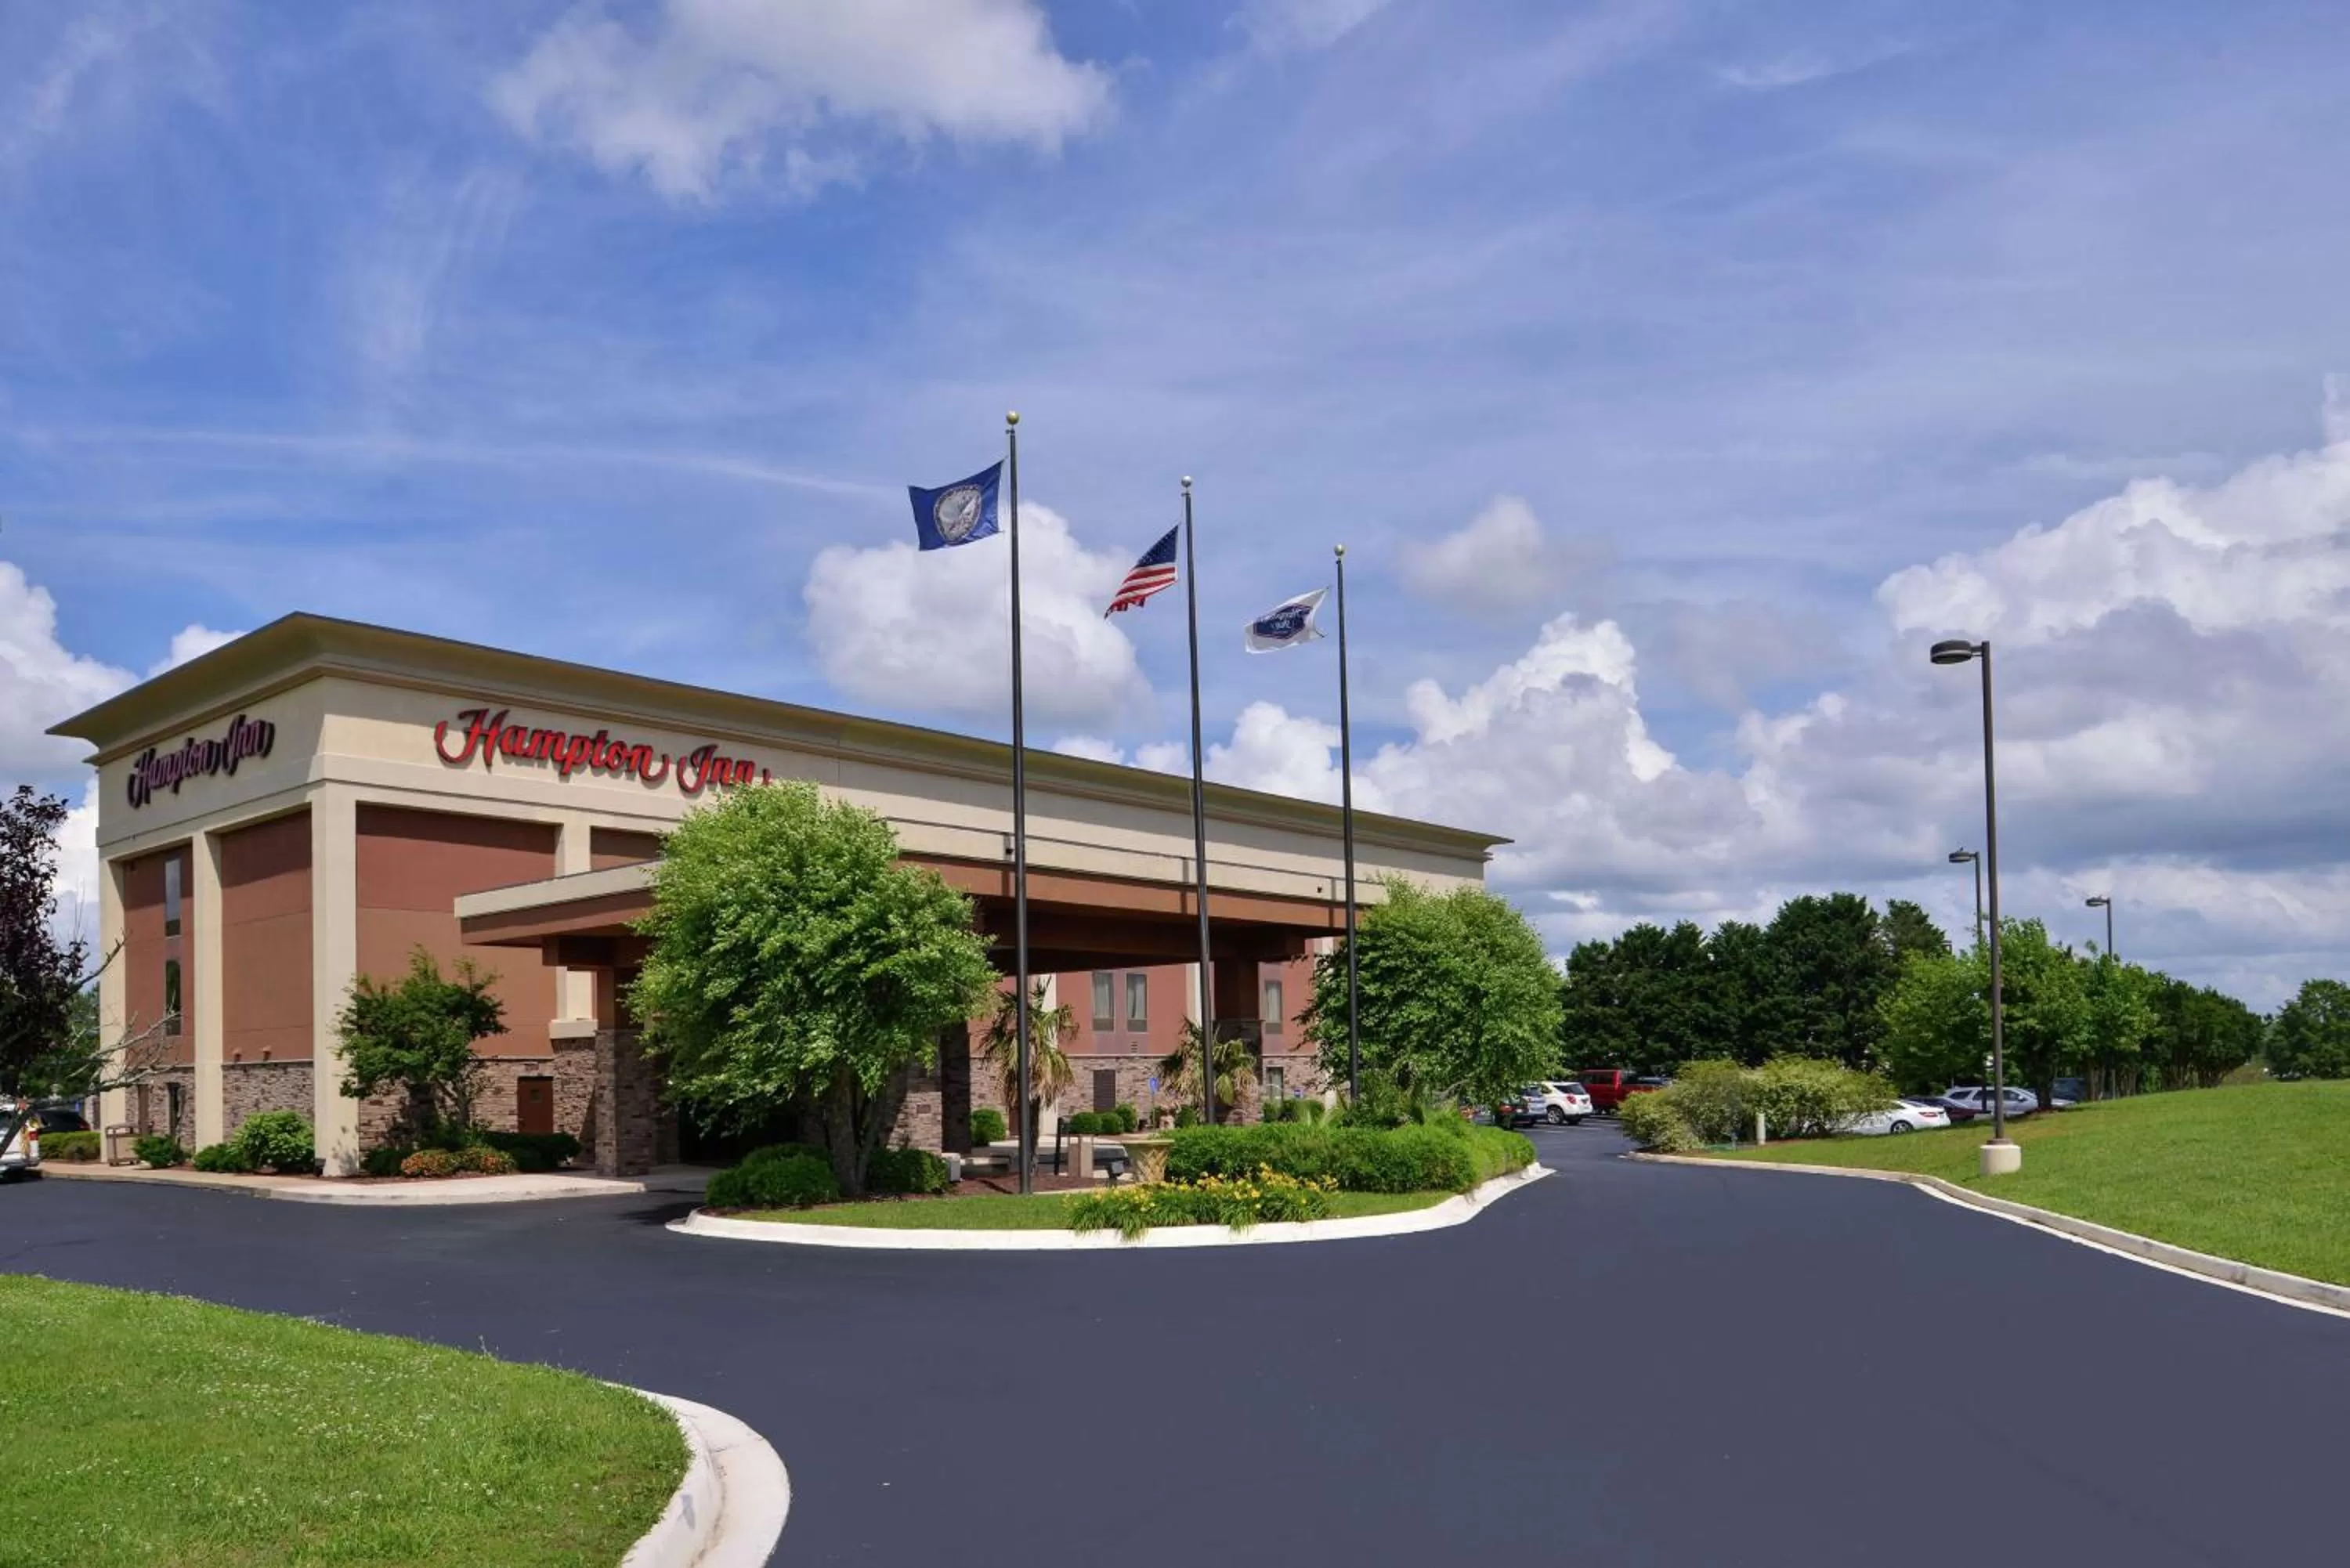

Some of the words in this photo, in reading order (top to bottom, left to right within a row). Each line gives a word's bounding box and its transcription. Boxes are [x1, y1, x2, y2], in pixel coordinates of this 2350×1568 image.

[128, 737, 222, 809] Hampton
[222, 714, 276, 777] Inn
[433, 707, 671, 782] Hampton
[677, 744, 771, 793] Inn
